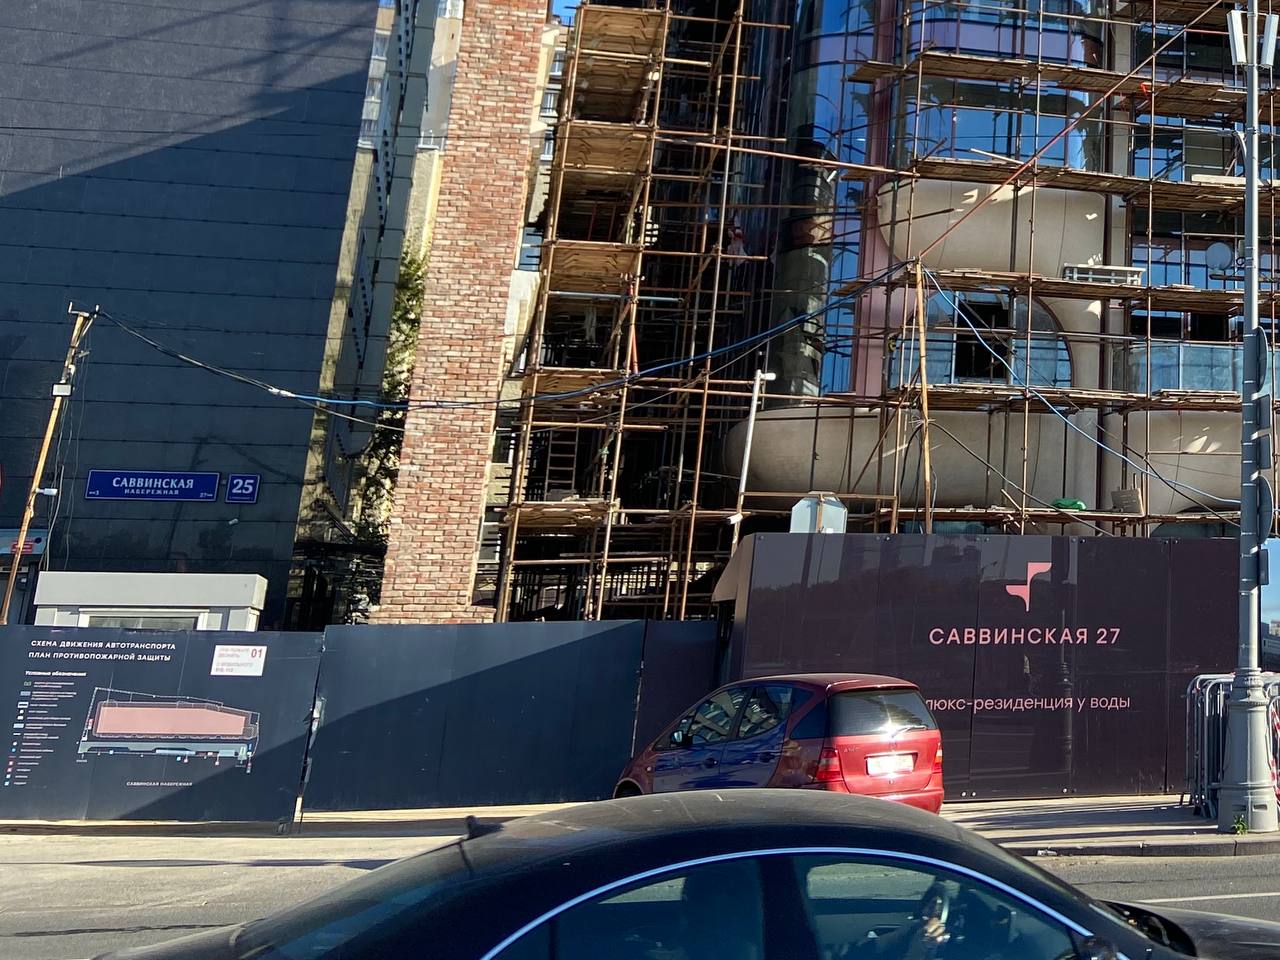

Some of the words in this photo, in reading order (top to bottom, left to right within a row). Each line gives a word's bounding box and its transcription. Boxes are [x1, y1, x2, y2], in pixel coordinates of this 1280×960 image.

[112, 477, 194, 489] САВВИНСКАЯ
[231, 479, 254, 494] 25
[928, 627, 1089, 645] САВВИНСКАЯ
[1096, 627, 1121, 645] 27
[105, 642, 176, 650] АВТОТРАНСПОРТА
[28, 651, 51, 659] ПЛАН
[53, 652, 135, 661] ПРОТИВОПОЖАРНОЙ
[137, 654, 171, 662] ЗАЩИТЫ
[251, 648, 263, 659] 01
[1077, 698, 1086, 713] у
[1090, 696, 1130, 710] воды
